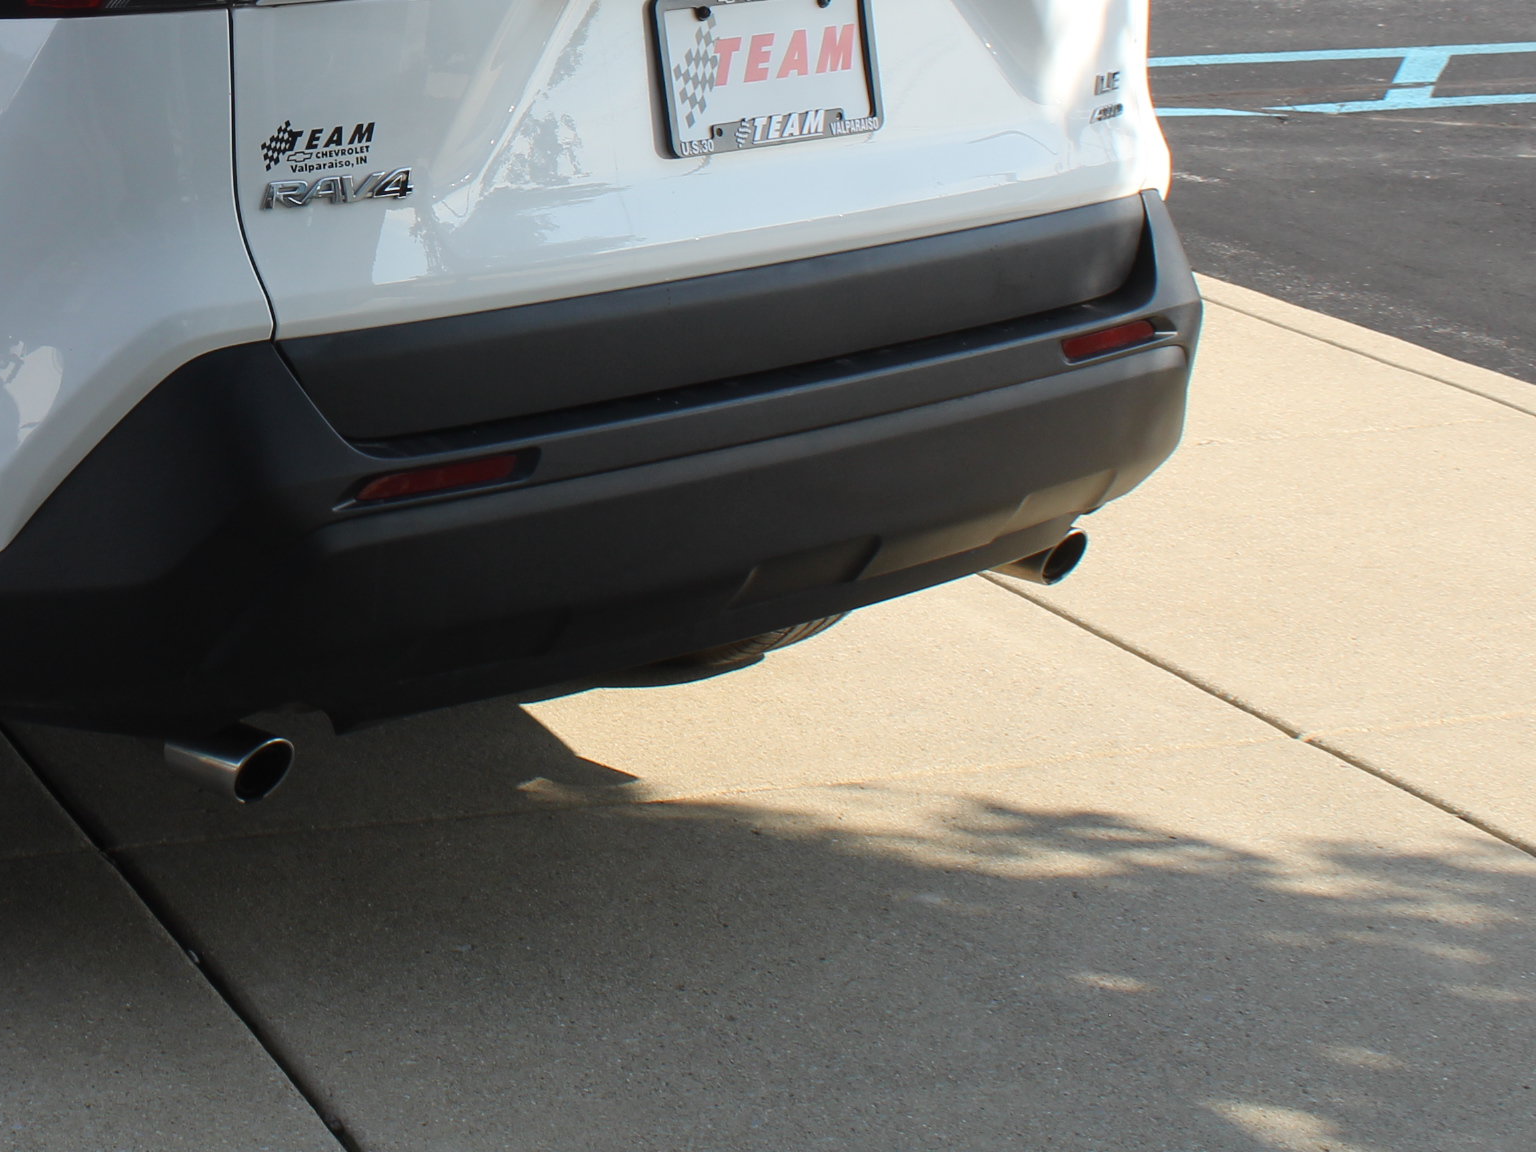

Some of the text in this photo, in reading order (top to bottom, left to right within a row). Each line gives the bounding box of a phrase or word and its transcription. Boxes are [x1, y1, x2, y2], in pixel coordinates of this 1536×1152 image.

[714, 24, 855, 87] TEAM
[1094, 71, 1120, 96] LE
[288, 122, 375, 152] TEAM
[753, 109, 825, 142] TEAM
[829, 117, 879, 136] VALPARAISO
[315, 145, 370, 159] CHEVROLET
[261, 167, 415, 211] RAV4
